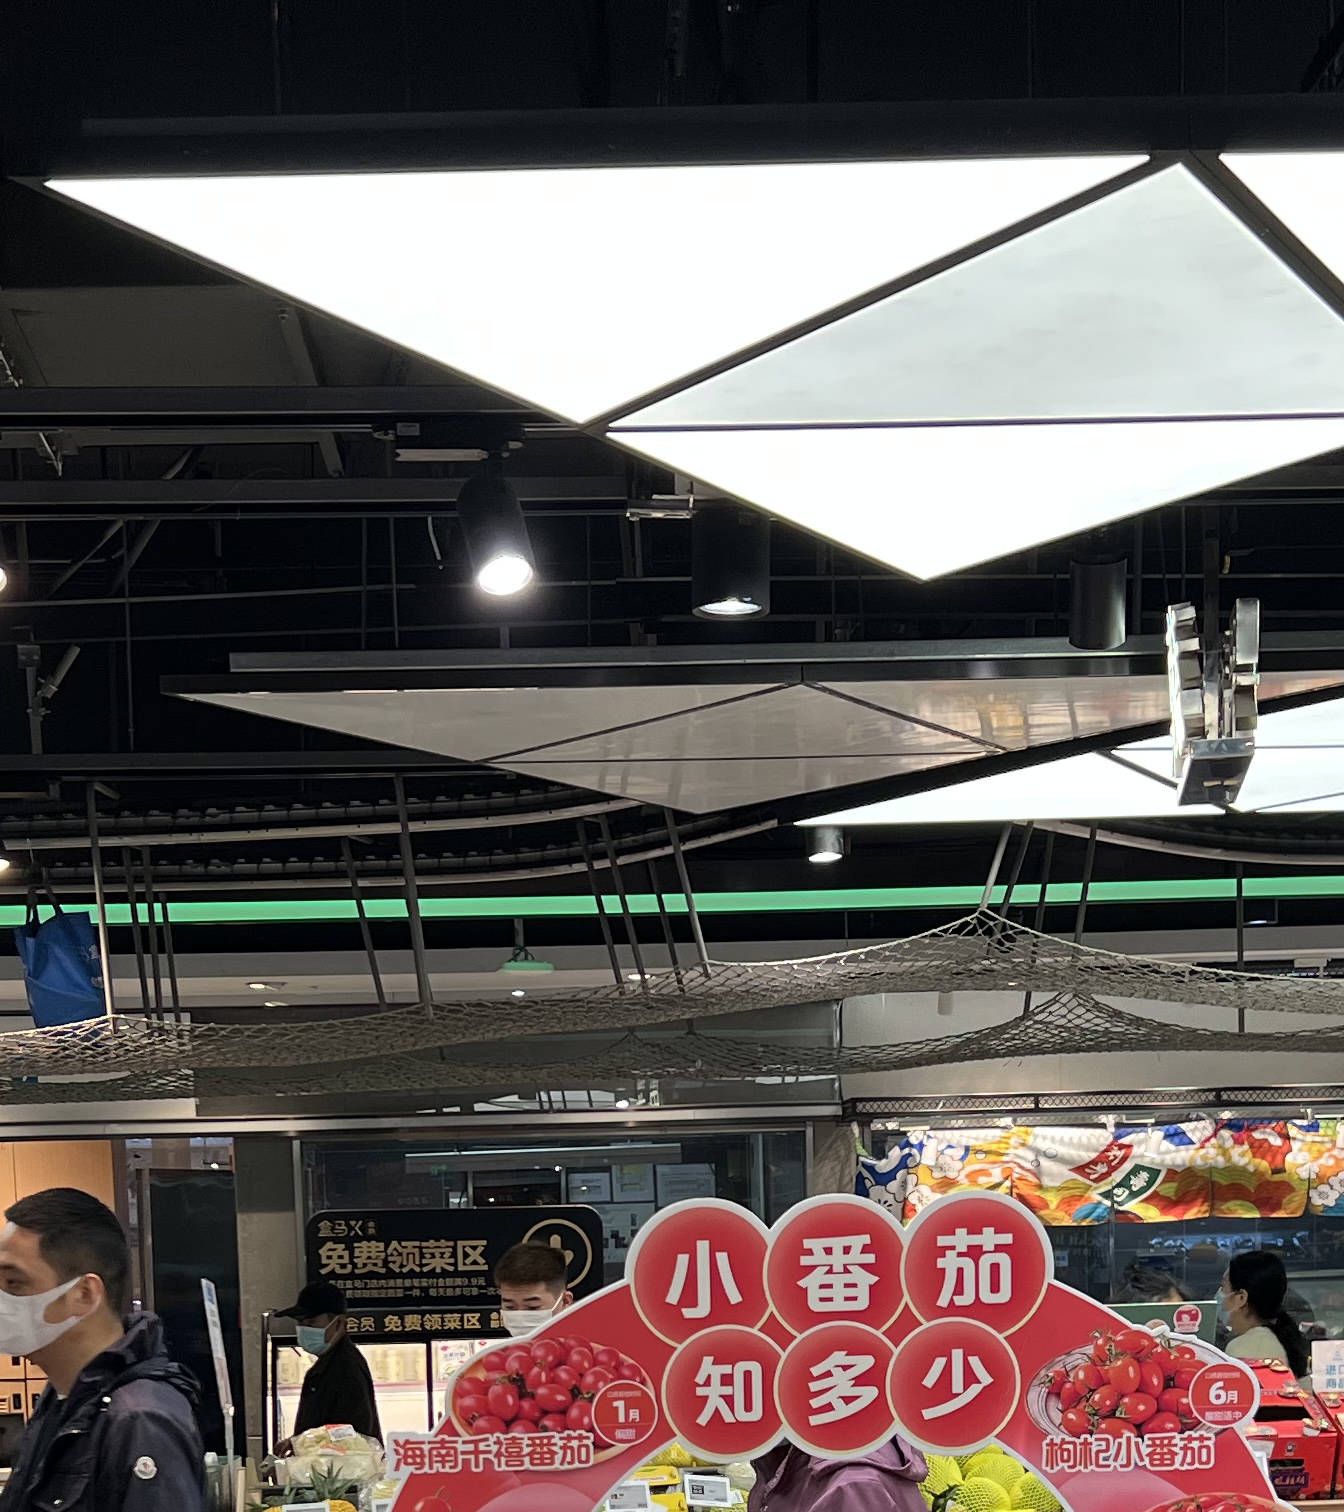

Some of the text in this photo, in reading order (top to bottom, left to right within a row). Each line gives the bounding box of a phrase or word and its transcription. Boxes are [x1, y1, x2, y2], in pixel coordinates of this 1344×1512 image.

[318, 1239, 490, 1275] 免费领菜区
[664, 1227, 1015, 1319] 小番茄
[384, 1313, 482, 1332] 免费领菜区
[694, 1347, 995, 1427] 知多少
[1208, 1380, 1238, 1406] 6月
[612, 1399, 640, 1423] 1月
[392, 1433, 594, 1472] 海南千禧番茄
[1044, 1433, 1214, 1470] 枸杞小番茄
